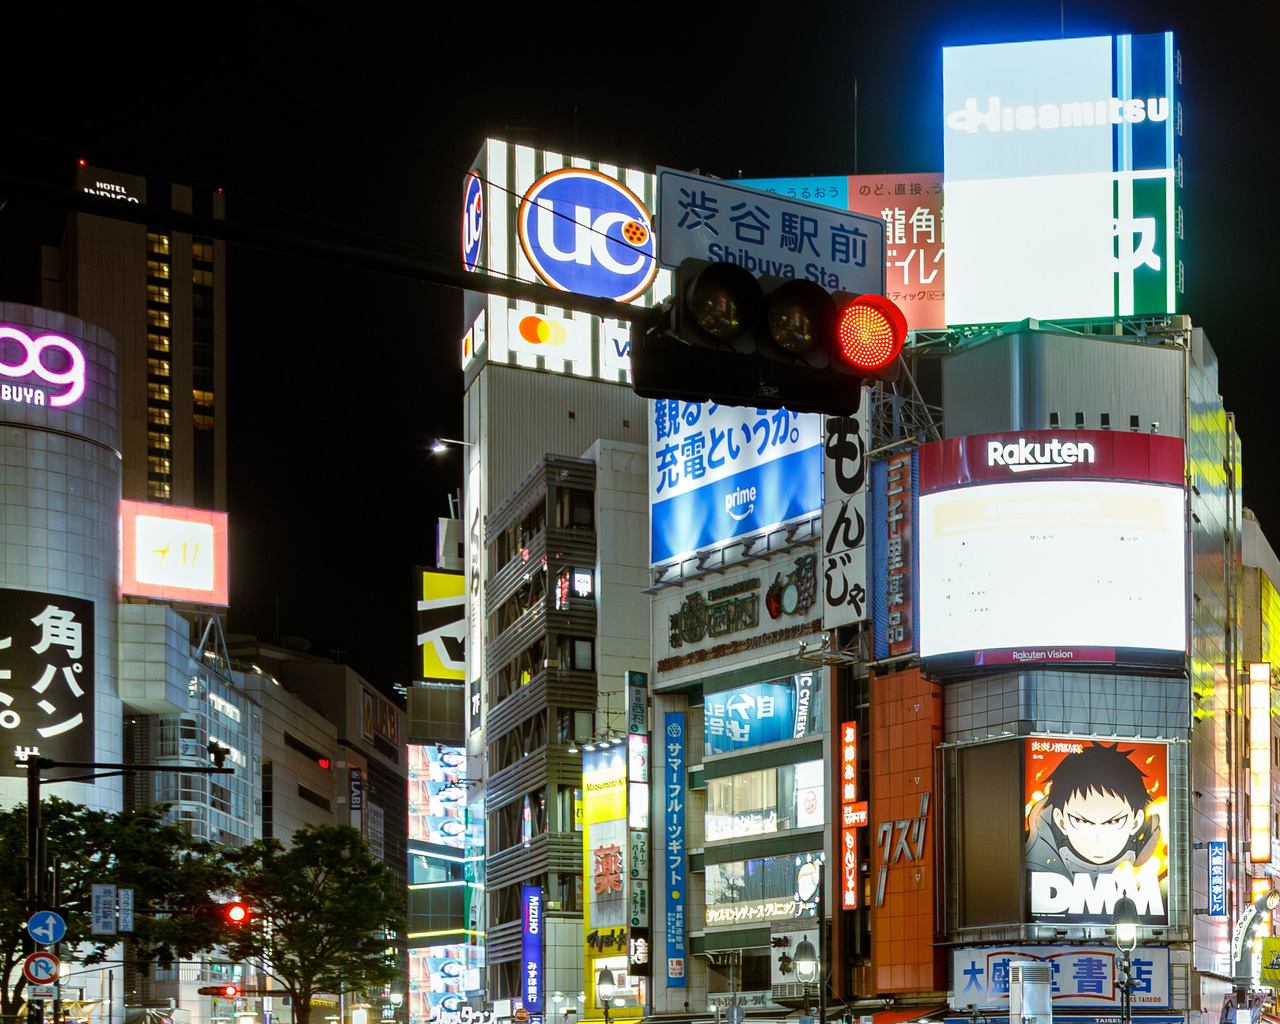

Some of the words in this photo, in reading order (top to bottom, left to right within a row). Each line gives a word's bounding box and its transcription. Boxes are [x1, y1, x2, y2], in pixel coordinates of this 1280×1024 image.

[946, 96, 1170, 134] Hisamitsu
[96, 181, 127, 194] HOTEL
[678, 187, 868, 268] 渋谷駅前
[708, 243, 796, 281] Shibuya
[804, 262, 847, 291] Sta.
[1, 384, 45, 406] BUYA
[655, 411, 800, 494] 充電というか。
[987, 438, 1096, 466] Rakuten
[725, 486, 757, 514] prime
[825, 415, 866, 618] もんじゃ
[886, 460, 905, 645] 三千里薬品
[30, 604, 85, 739] 角パン
[1012, 651, 1046, 662] Rakuten
[1047, 651, 1073, 660] Vision
[351, 782, 361, 809] LABI
[586, 778, 617, 792] Matsumoto
[667, 743, 682, 886] サマーフルーツギフト
[593, 843, 624, 895] 薬
[1212, 846, 1223, 913] 大盛堂商事ビル
[1031, 871, 1165, 916] DMM
[528, 896, 539, 935] MIZUHO
[527, 961, 537, 1003] みずほ銀行
